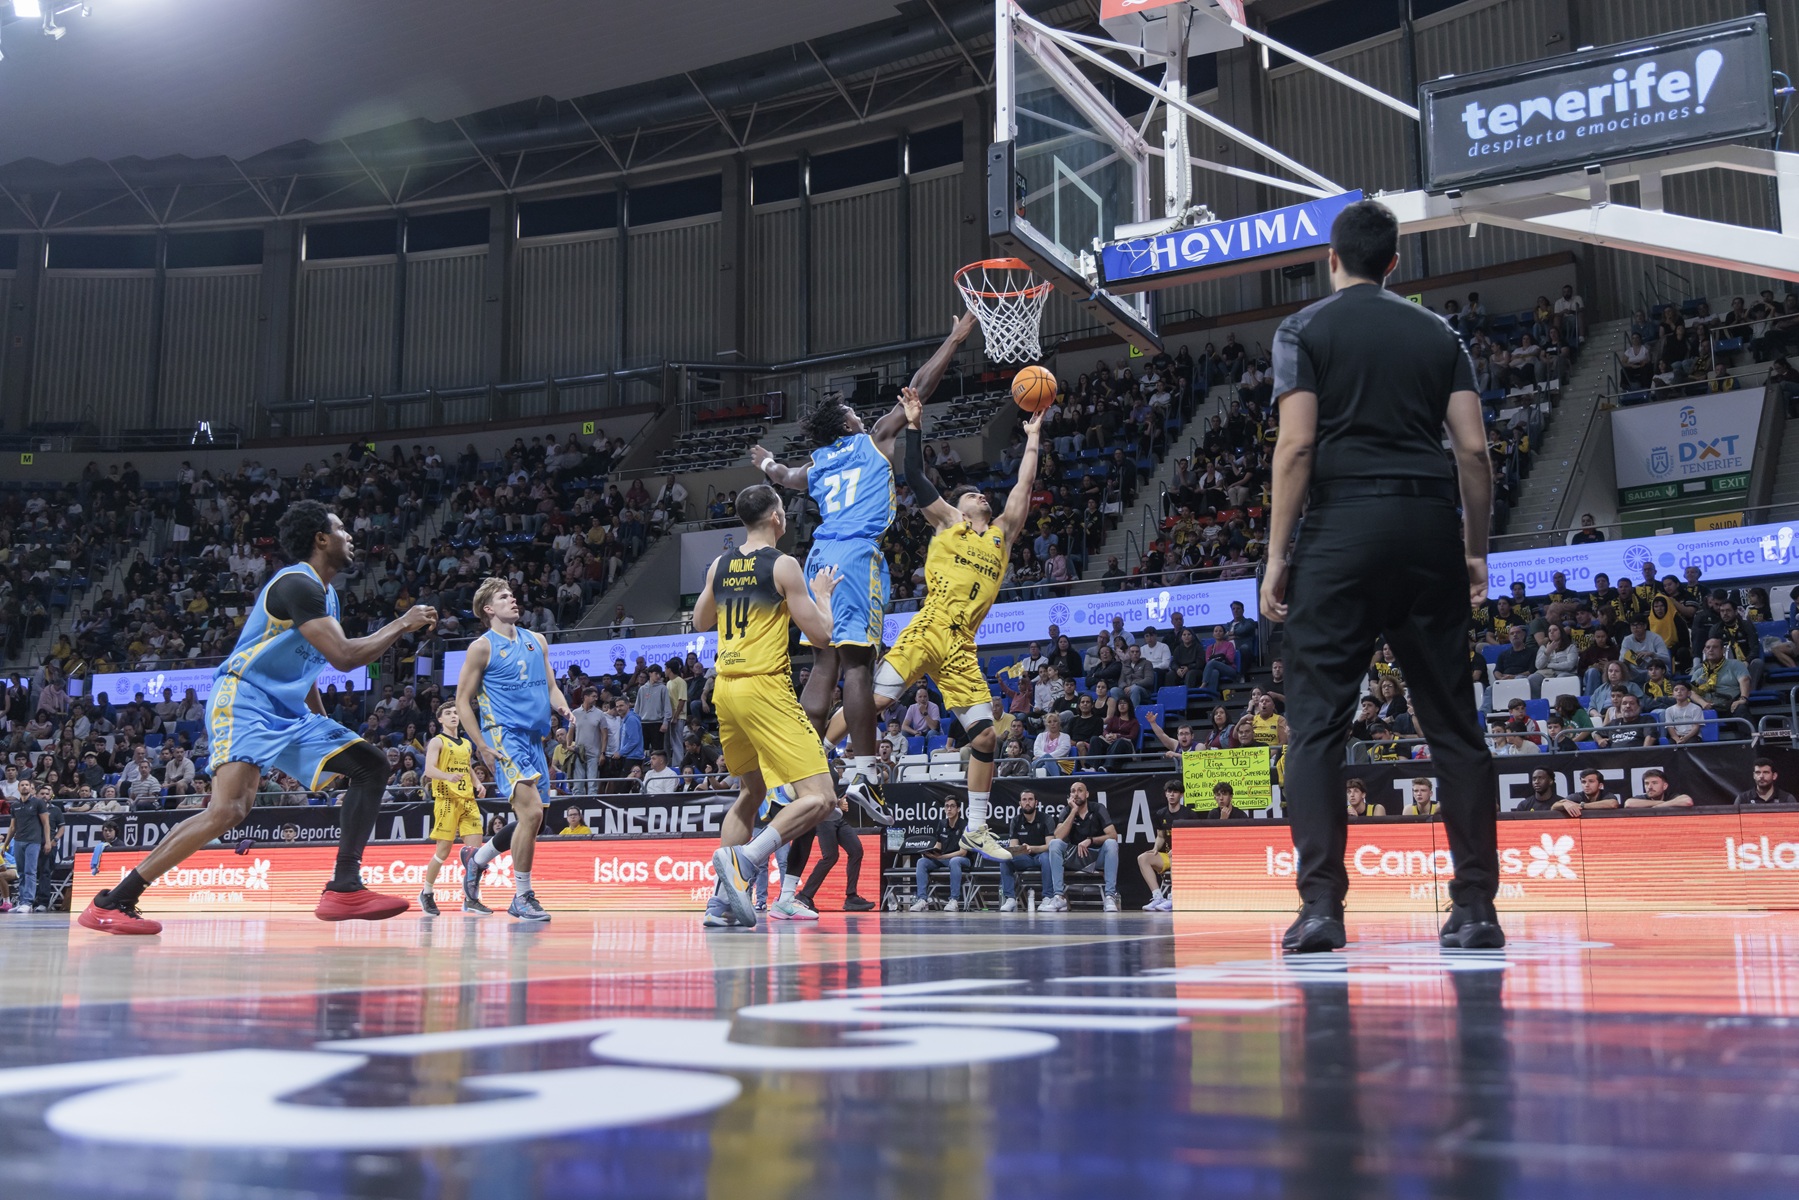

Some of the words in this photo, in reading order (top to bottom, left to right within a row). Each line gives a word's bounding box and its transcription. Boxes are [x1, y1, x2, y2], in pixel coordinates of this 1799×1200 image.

[1461, 49, 1724, 140] tenerife!
[1468, 130, 1566, 157] despierta
[1576, 105, 1691, 137] emociones
[1151, 208, 1318, 271] HOVIMA
[1680, 409, 1697, 428] 25
[1681, 428, 1698, 437] años
[1678, 434, 1740, 463] DXT
[1680, 456, 1743, 475] TENERIFE
[823, 467, 862, 514] 27
[1719, 476, 1746, 489] EXIT
[1627, 490, 1661, 501] SALIDA
[1709, 519, 1738, 531] SALIDA
[1677, 540, 1730, 551] Organismo
[1487, 560, 1532, 570] Autónomo
[1535, 557, 1545, 565] de
[1548, 553, 1589, 565] Deportes
[1679, 551, 1756, 573] deporte
[722, 576, 758, 587] HOVIMA
[969, 581, 981, 601] 6
[1087, 600, 1125, 610] Organismo
[1176, 591, 1210, 601] Deportes
[725, 596, 749, 641] 14
[995, 610, 1025, 618] Deportes
[1088, 608, 1143, 627] deporte
[976, 620, 1026, 639] gunero
[567, 649, 591, 657] Deportes
[640, 643, 671, 651] Organismo
[516, 659, 529, 681] 2
[457, 779, 467, 791] 22
[887, 801, 948, 821] bellón
[984, 801, 1066, 824] Deptes
[223, 824, 269, 840] abellón
[908, 825, 934, 834] Martín
[1264, 845, 1299, 876] Isl
[1353, 844, 1524, 876] Canas
[1725, 835, 1799, 871] Isla
[163, 863, 245, 888] Canarias
[594, 856, 649, 883] Islas
[654, 856, 717, 882] Cana
